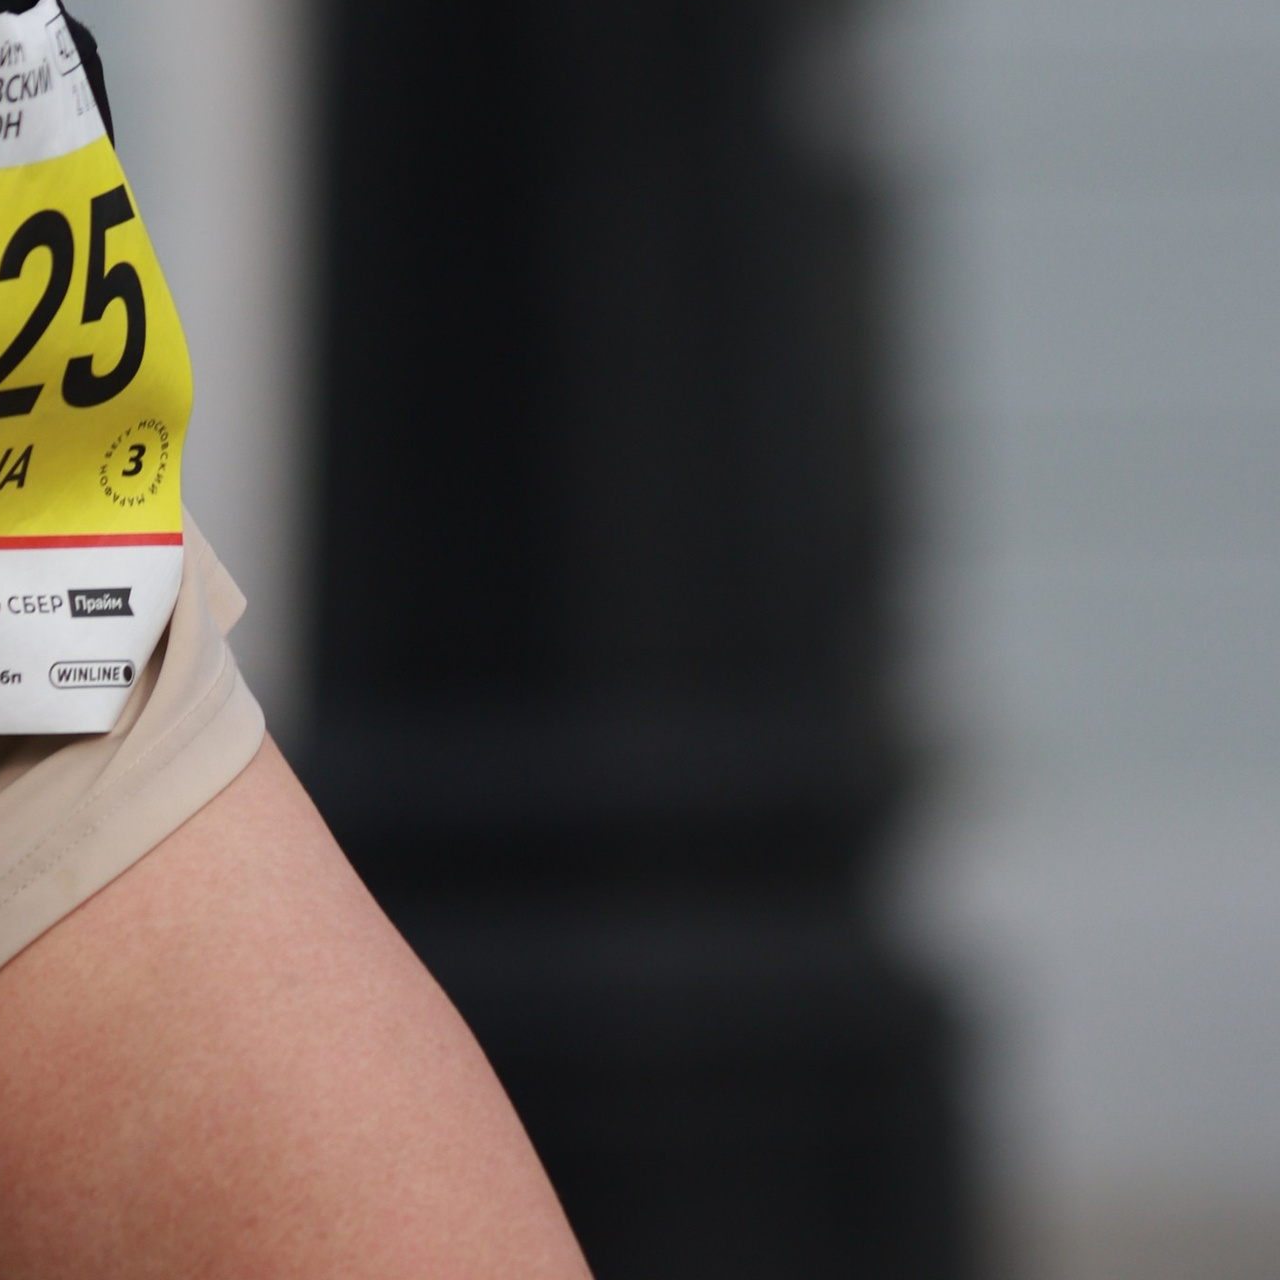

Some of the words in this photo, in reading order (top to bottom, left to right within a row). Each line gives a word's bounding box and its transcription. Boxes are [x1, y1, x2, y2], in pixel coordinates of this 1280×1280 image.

[121, 443, 147, 477] 3
[7, 594, 64, 615] СБЕР
[74, 592, 123, 614] Прайм
[57, 665, 121, 683] WINLINE
